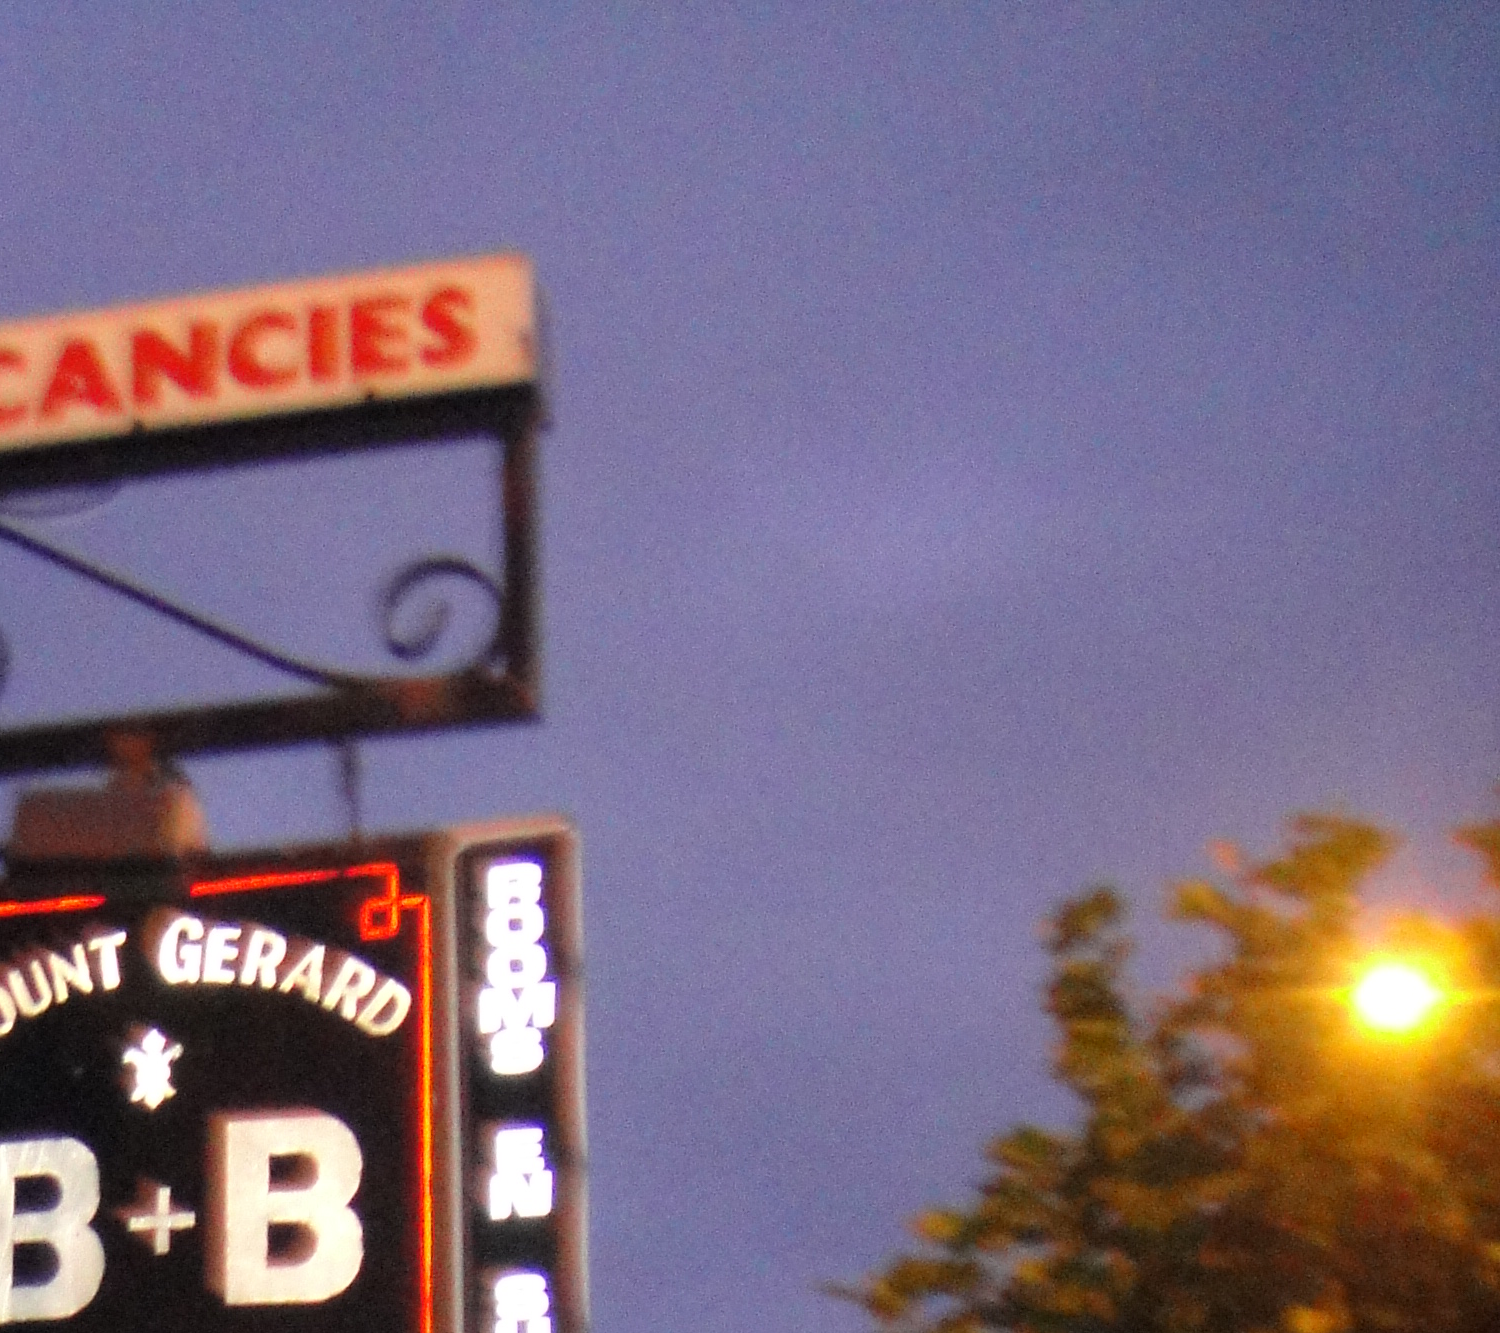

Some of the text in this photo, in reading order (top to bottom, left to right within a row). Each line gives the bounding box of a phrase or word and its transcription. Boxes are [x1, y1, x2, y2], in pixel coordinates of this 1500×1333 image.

[158, 916, 412, 1036] GERARD
[479, 862, 556, 1075] ROOMS
[490, 1127, 553, 1221] EN
